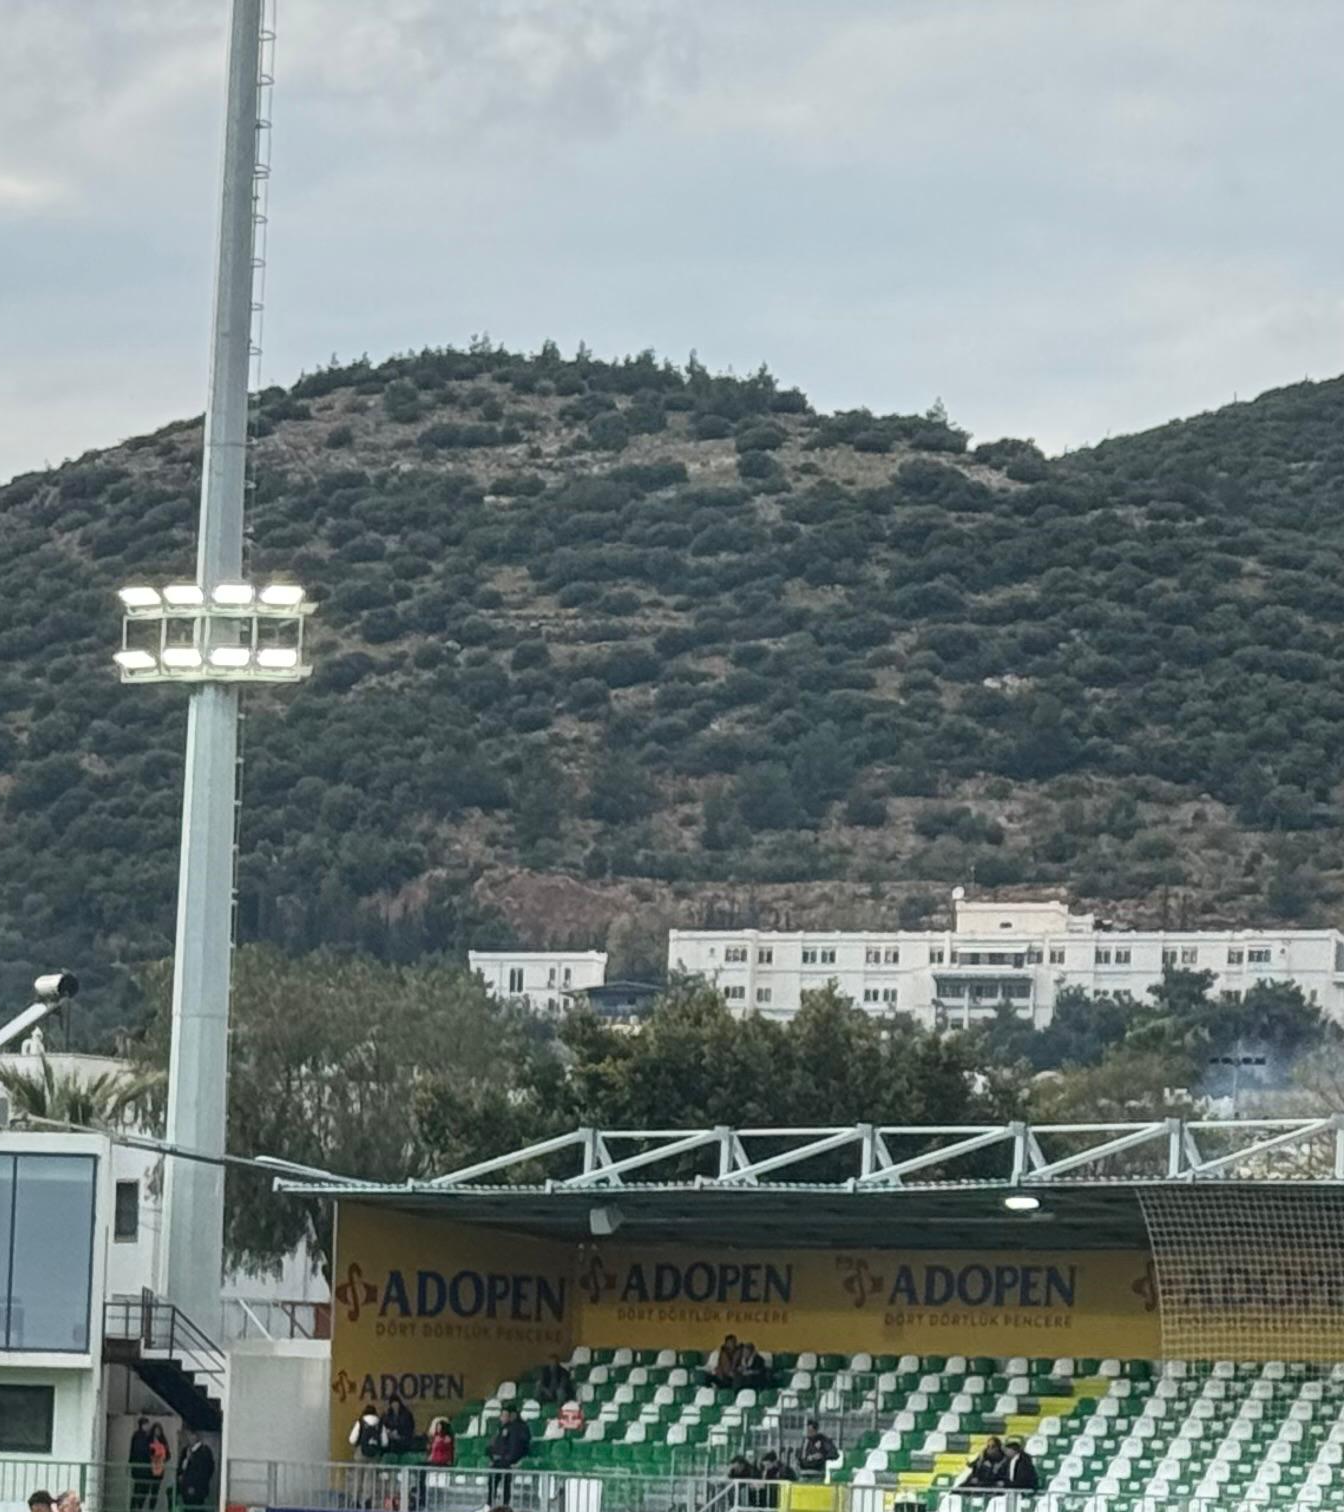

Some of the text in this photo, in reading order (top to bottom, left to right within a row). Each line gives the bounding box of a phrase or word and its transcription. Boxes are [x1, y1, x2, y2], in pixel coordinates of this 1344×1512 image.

[378, 1268, 568, 1322] ADOPEN
[620, 1262, 794, 1304] ADOPEN
[888, 1263, 1077, 1308] ADOPEN
[1003, 1315, 1073, 1330] PENCERE
[359, 1372, 465, 1400] ADOPEN
